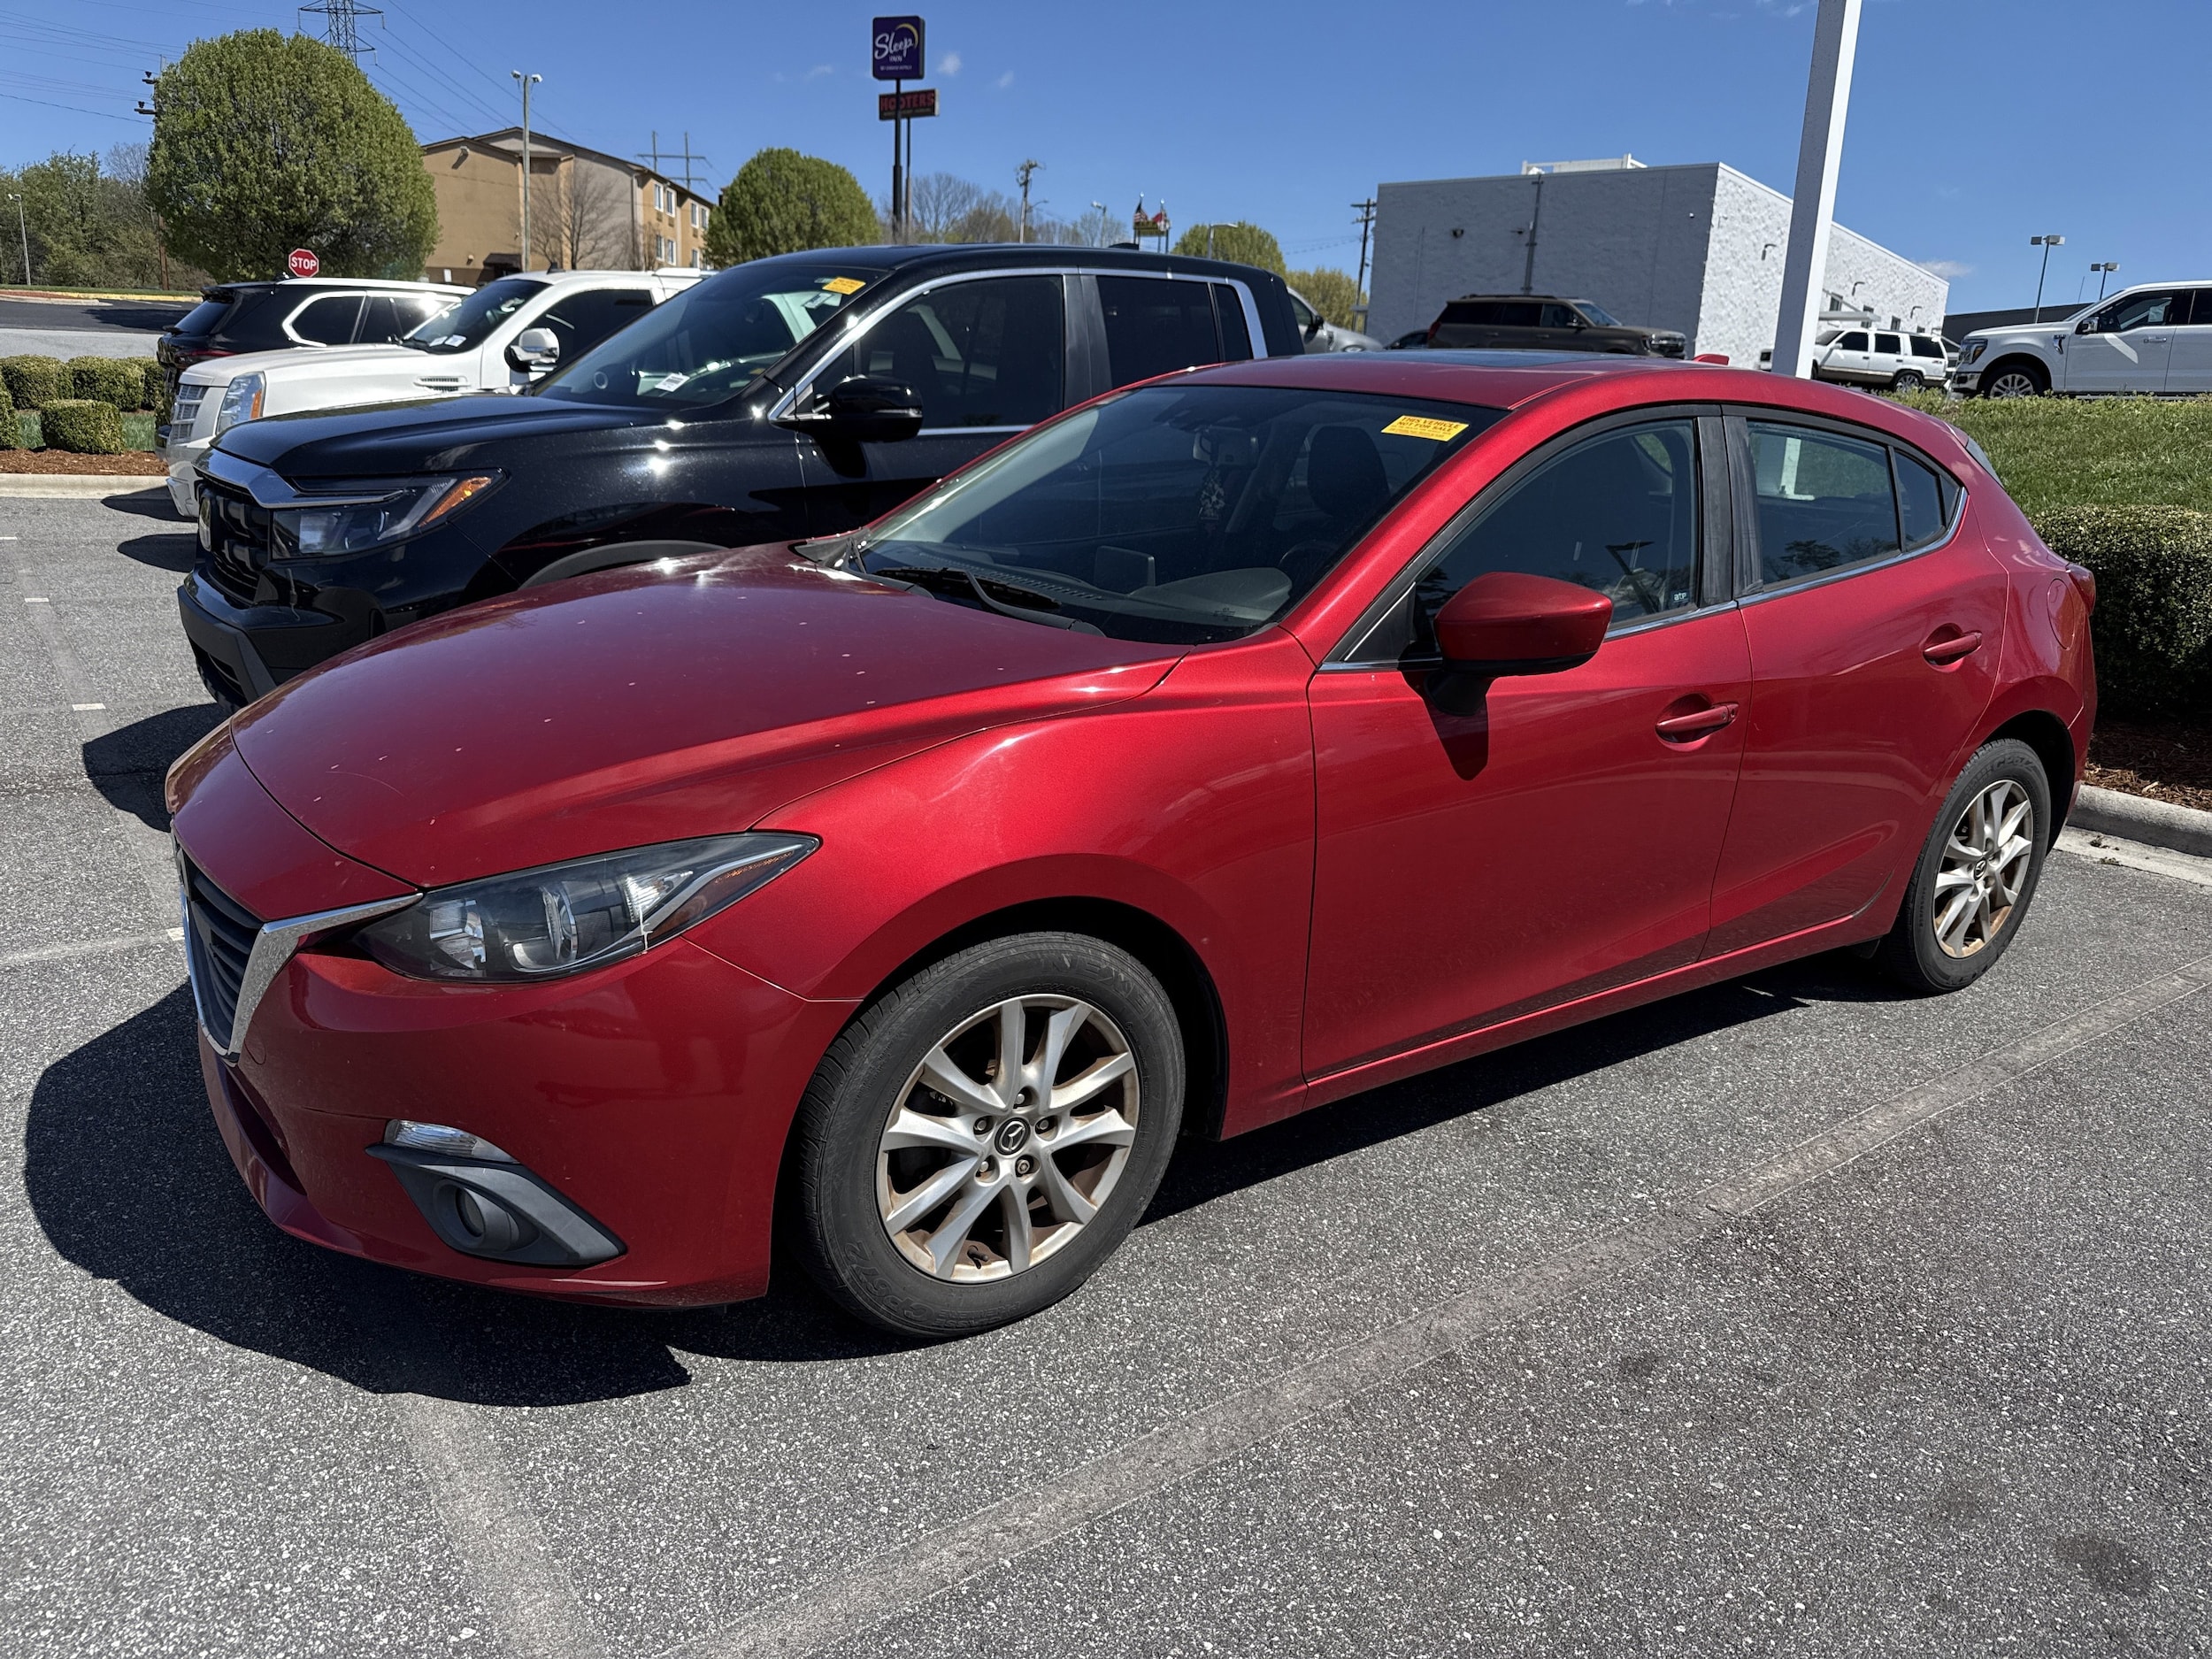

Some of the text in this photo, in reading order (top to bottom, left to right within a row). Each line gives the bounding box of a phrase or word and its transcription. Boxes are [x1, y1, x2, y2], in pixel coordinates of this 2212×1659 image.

[874, 32, 913, 59] Sleep
[880, 92, 934, 110] HOOTERS
[291, 257, 317, 270] STOP
